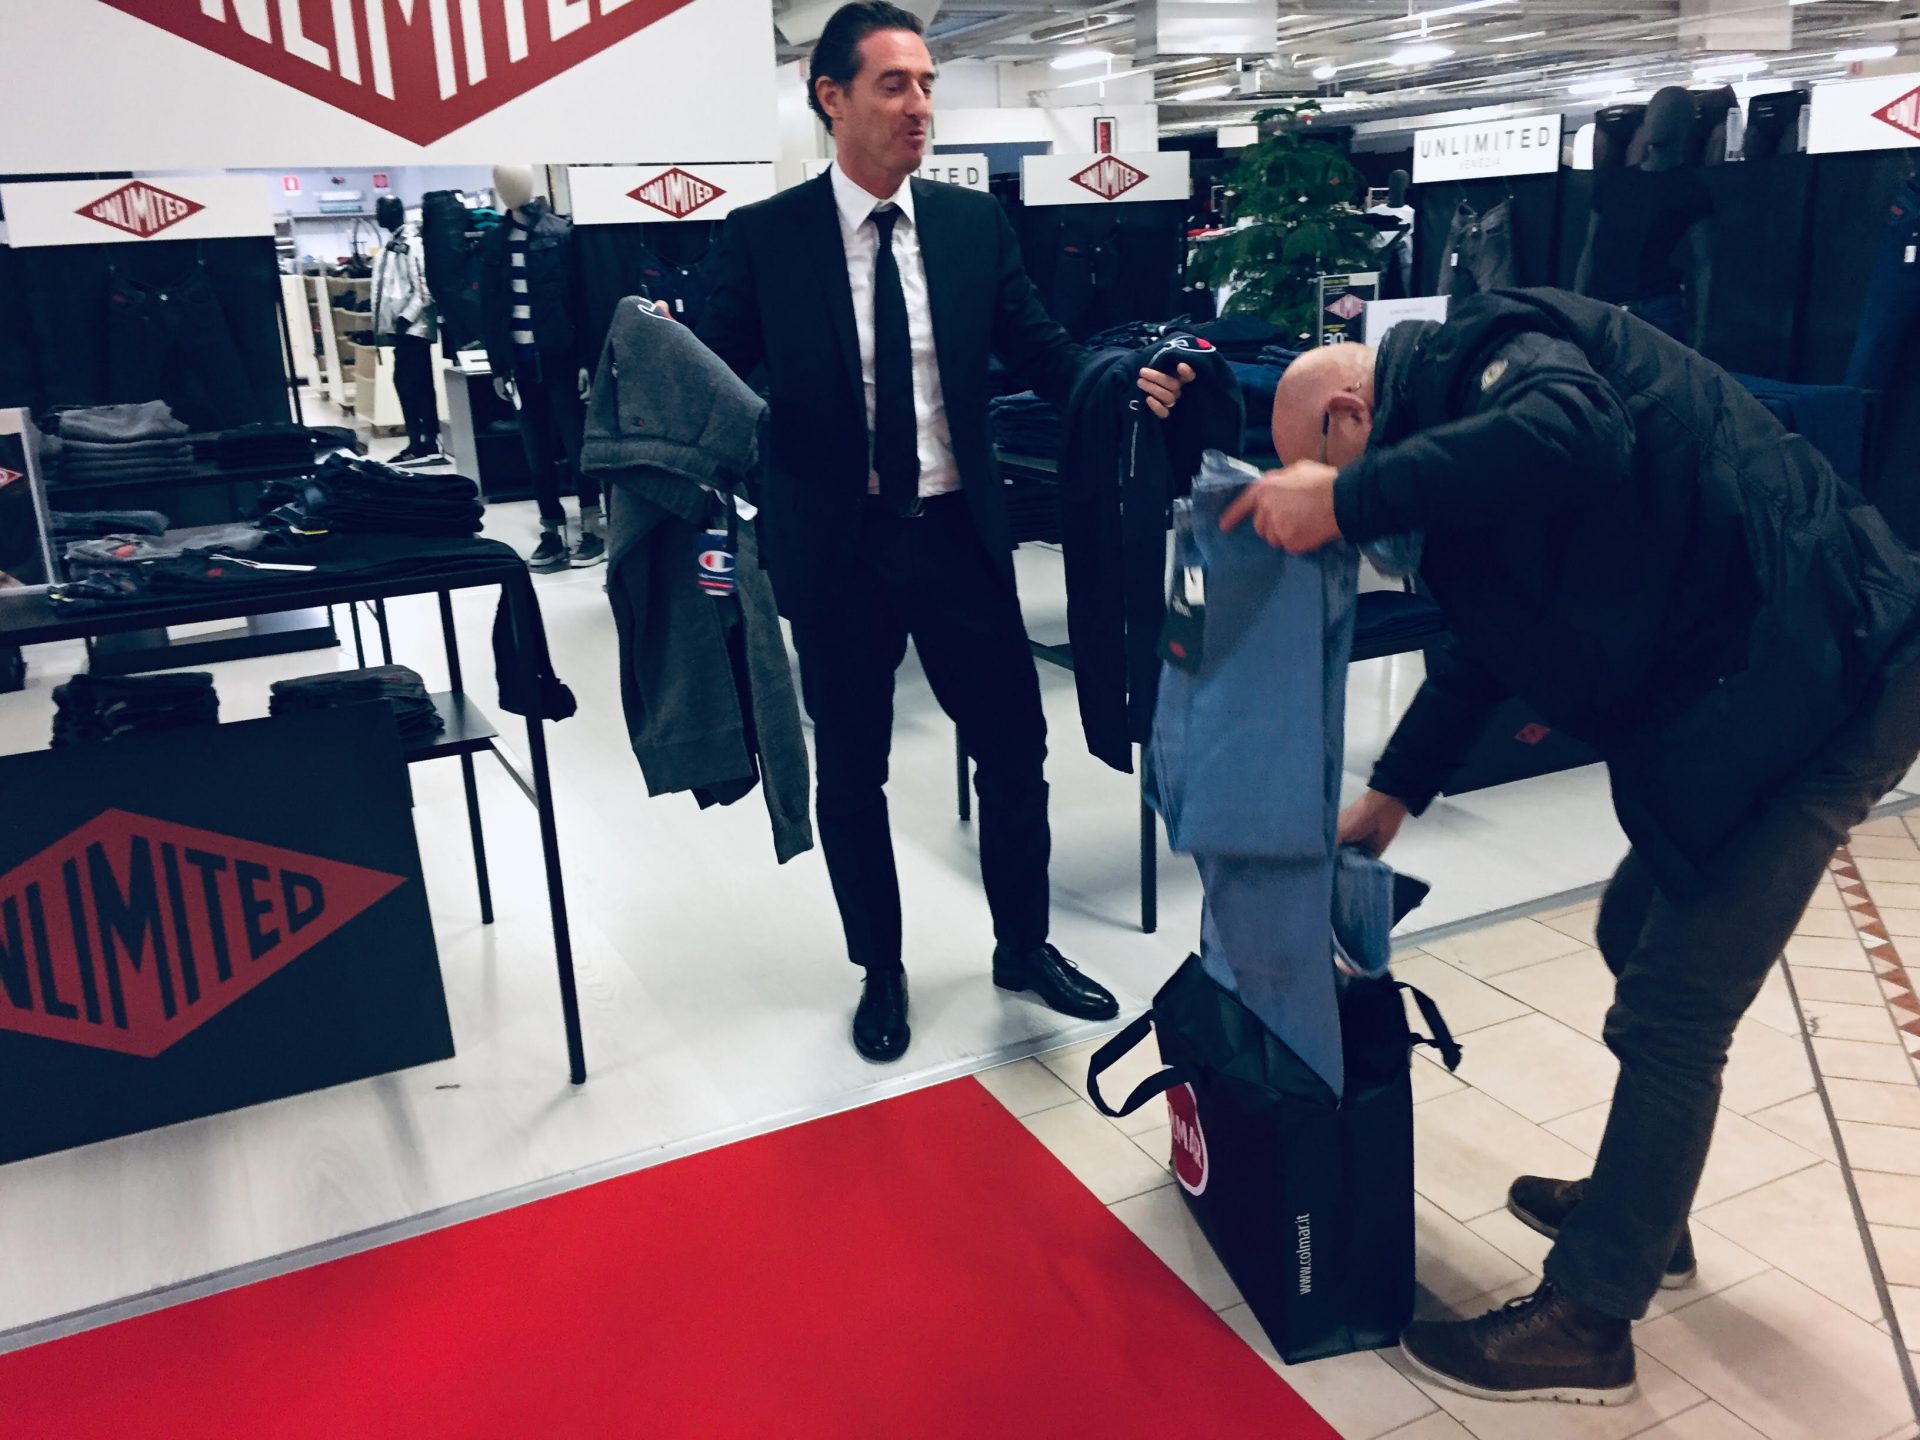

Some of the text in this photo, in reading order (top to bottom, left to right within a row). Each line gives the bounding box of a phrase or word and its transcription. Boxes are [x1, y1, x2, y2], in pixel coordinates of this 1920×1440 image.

[1420, 126, 1551, 159] UNLIMITED
[639, 172, 714, 214] UNLIMITED
[1079, 159, 1139, 197] UNLIMITED
[92, 186, 189, 232] UNLIMITED
[1295, 1212, 1312, 1296] www.colmar.it
